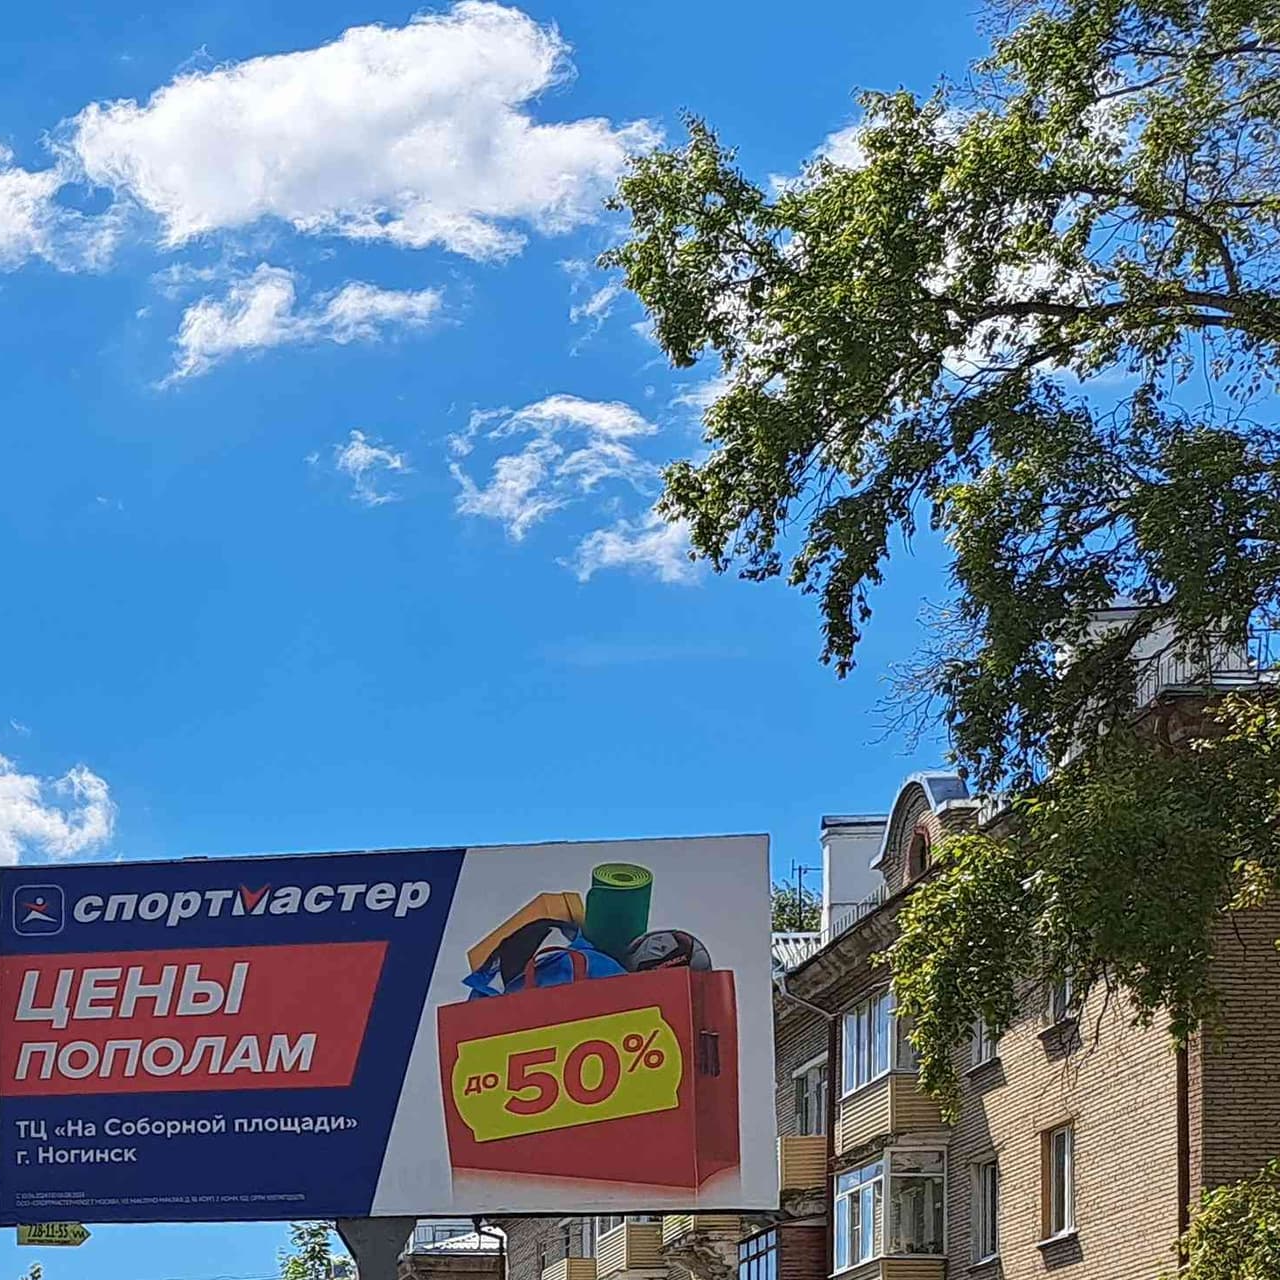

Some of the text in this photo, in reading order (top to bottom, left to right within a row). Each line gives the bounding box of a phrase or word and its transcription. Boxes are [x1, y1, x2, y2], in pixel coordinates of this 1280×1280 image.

[14, 961, 250, 1029] ЦЕНЫ
[14, 1033, 318, 1080] ПОПОЛАМ
[504, 1029, 665, 1116] 50%
[15, 1113, 358, 1141] ТЦ «На Соборной площади»
[16, 1146, 138, 1165] г. Ногинск
